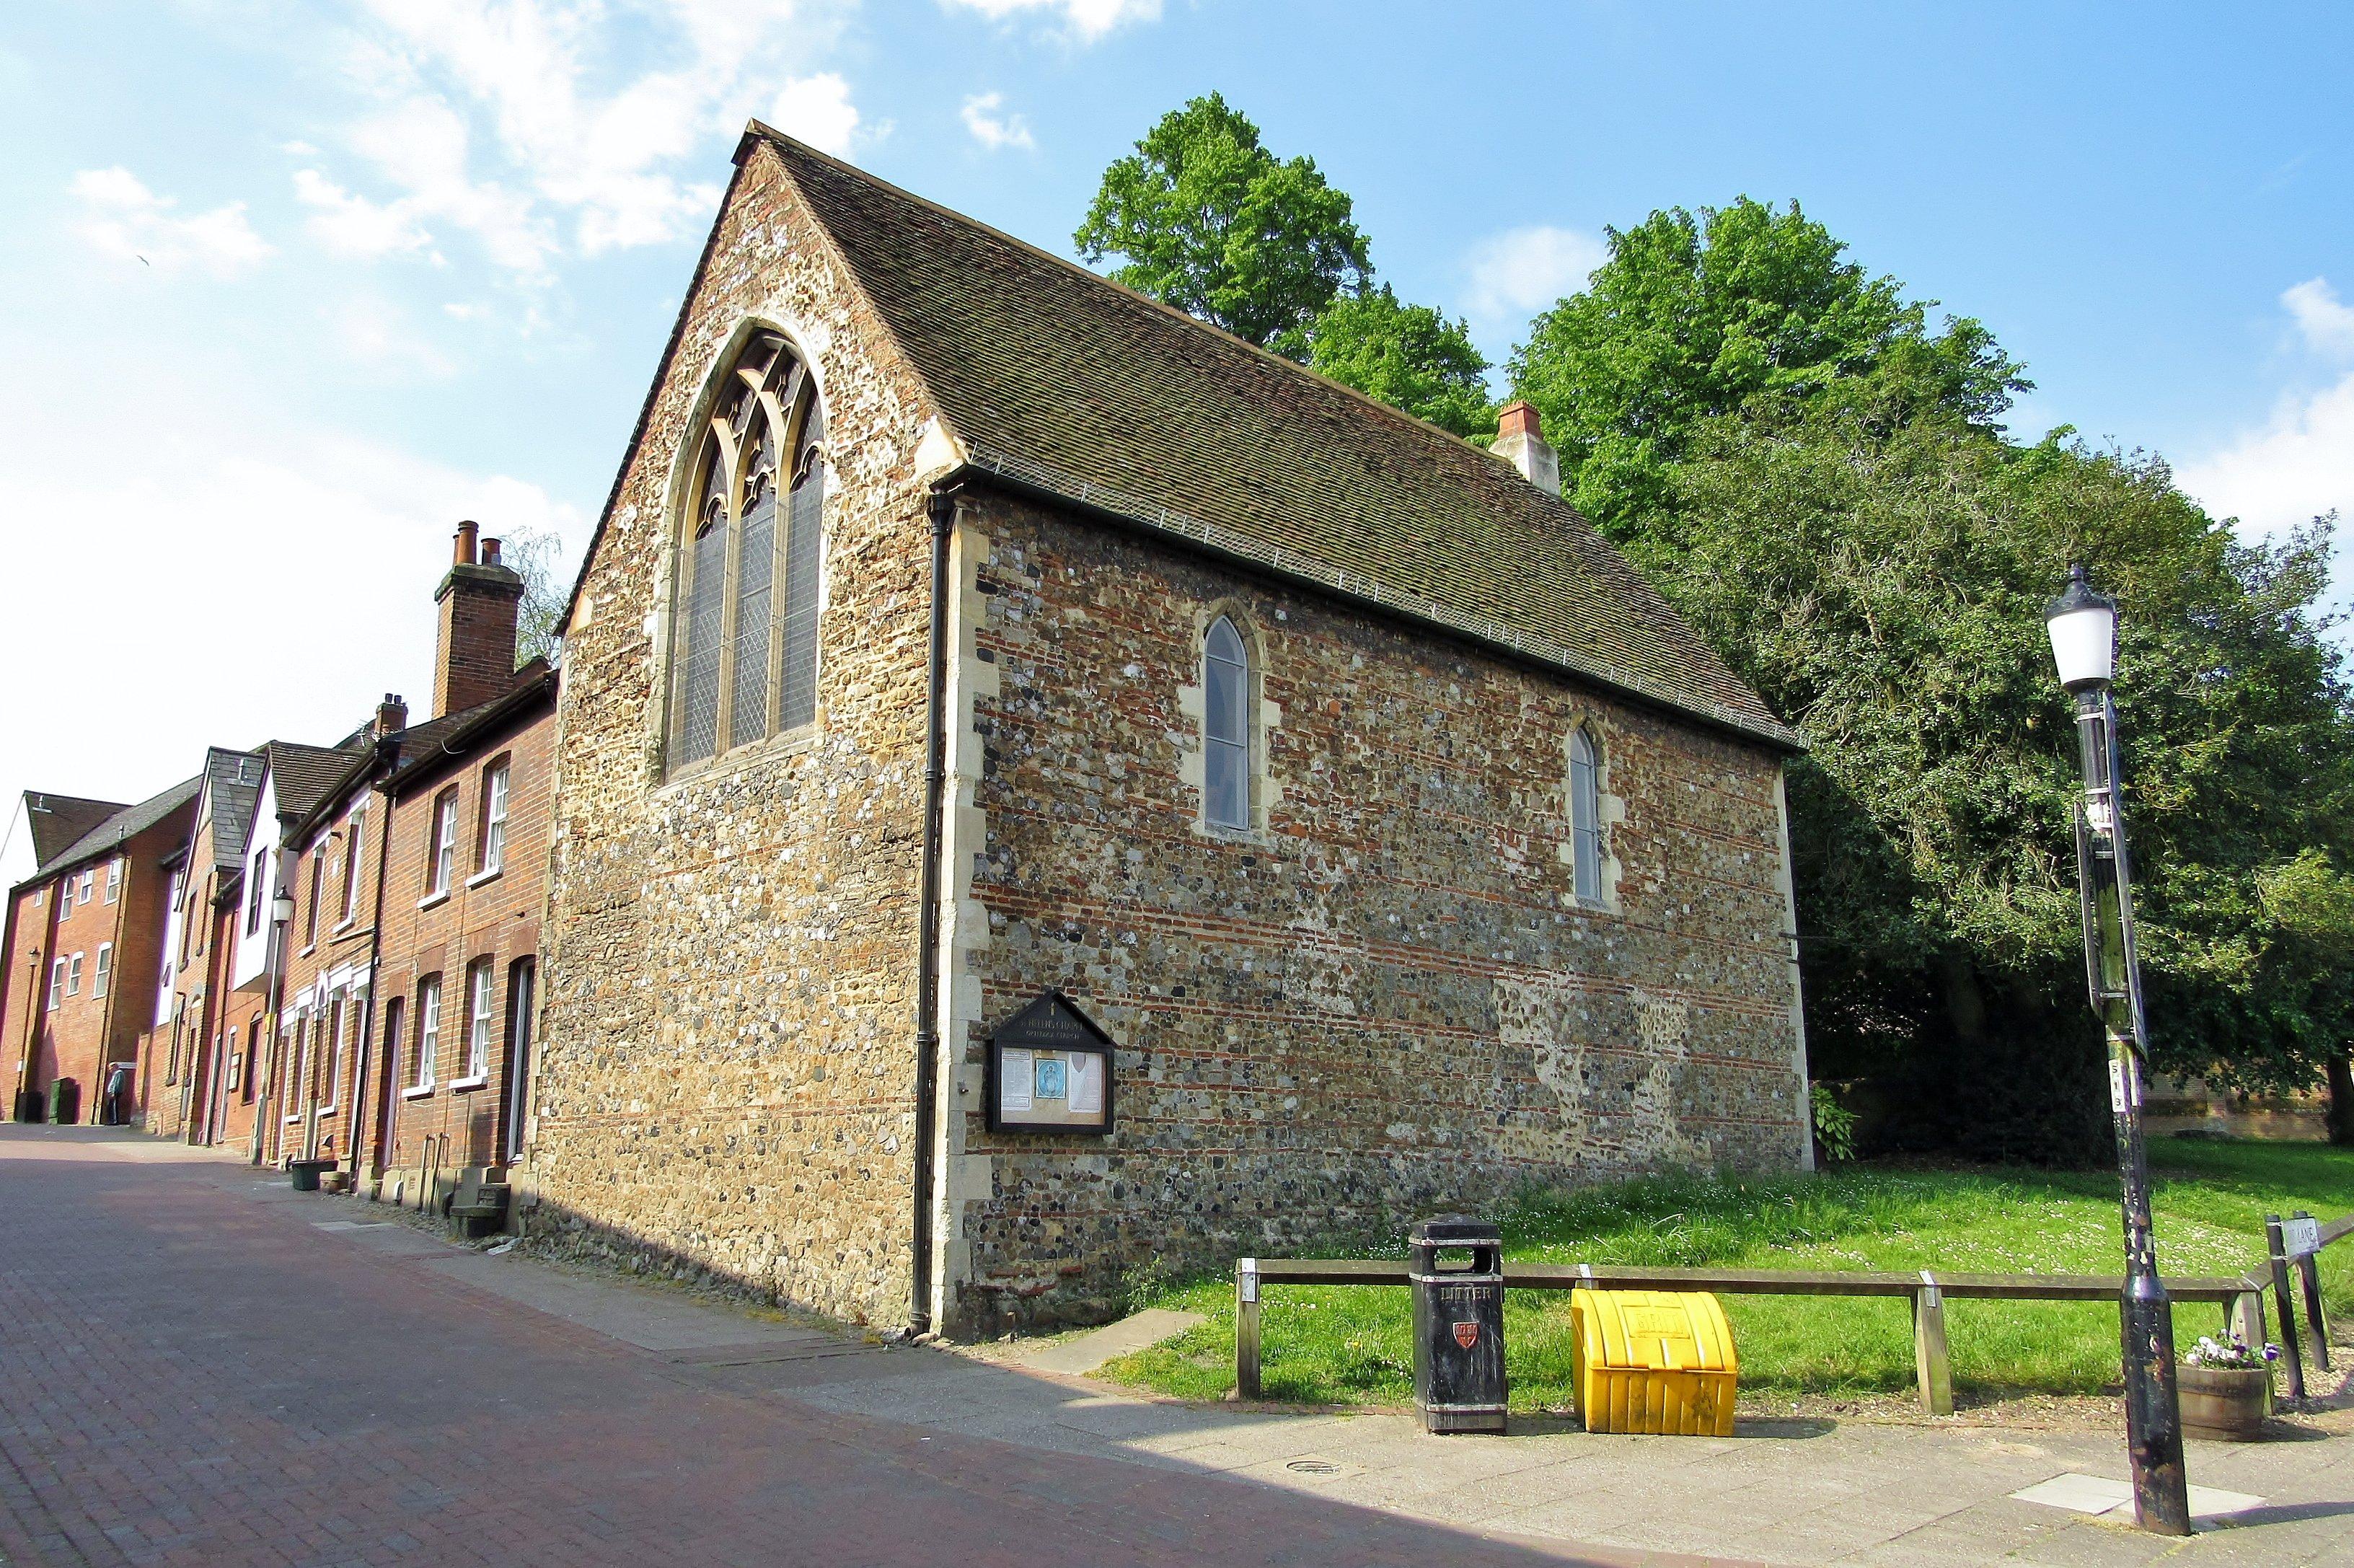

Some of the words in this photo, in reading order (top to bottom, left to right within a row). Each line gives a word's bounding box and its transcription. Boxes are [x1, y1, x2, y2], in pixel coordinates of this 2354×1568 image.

[2297, 1228, 2316, 1243] LANE
[1441, 1287, 1491, 1301] LITTER
[1635, 1311, 1684, 1334] GRIT
